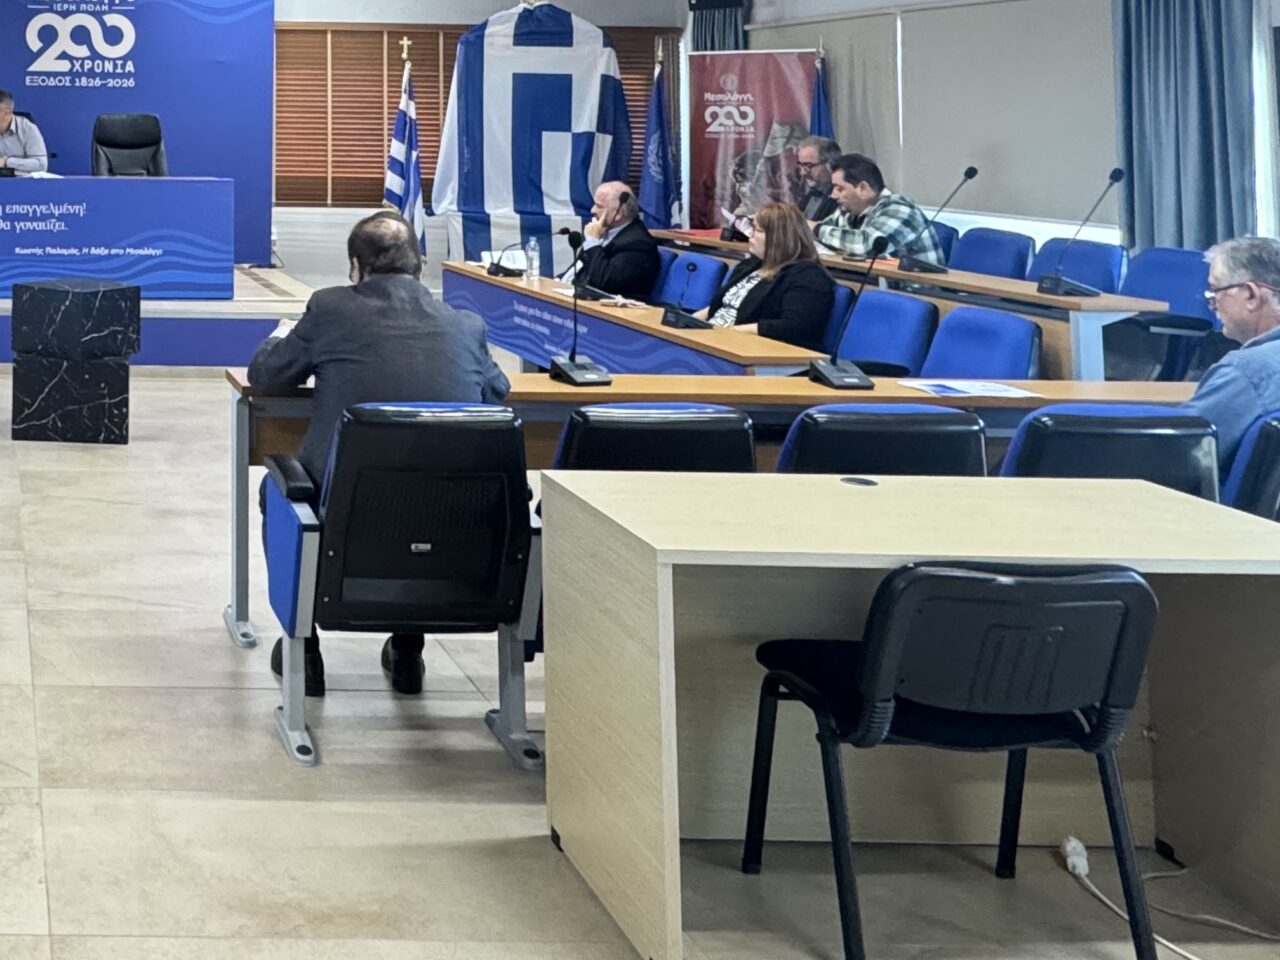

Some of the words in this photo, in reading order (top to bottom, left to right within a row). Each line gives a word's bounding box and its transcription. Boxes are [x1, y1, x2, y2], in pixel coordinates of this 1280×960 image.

[25, 12, 136, 72] 200
[73, 59, 135, 73] ΧΡΟΝΙΑ
[25, 75, 72, 86] ΕΞΟΔΟΣ
[5, 202, 87, 217] επαγγελμένη!
[14, 218, 68, 234] γονατίζει.
